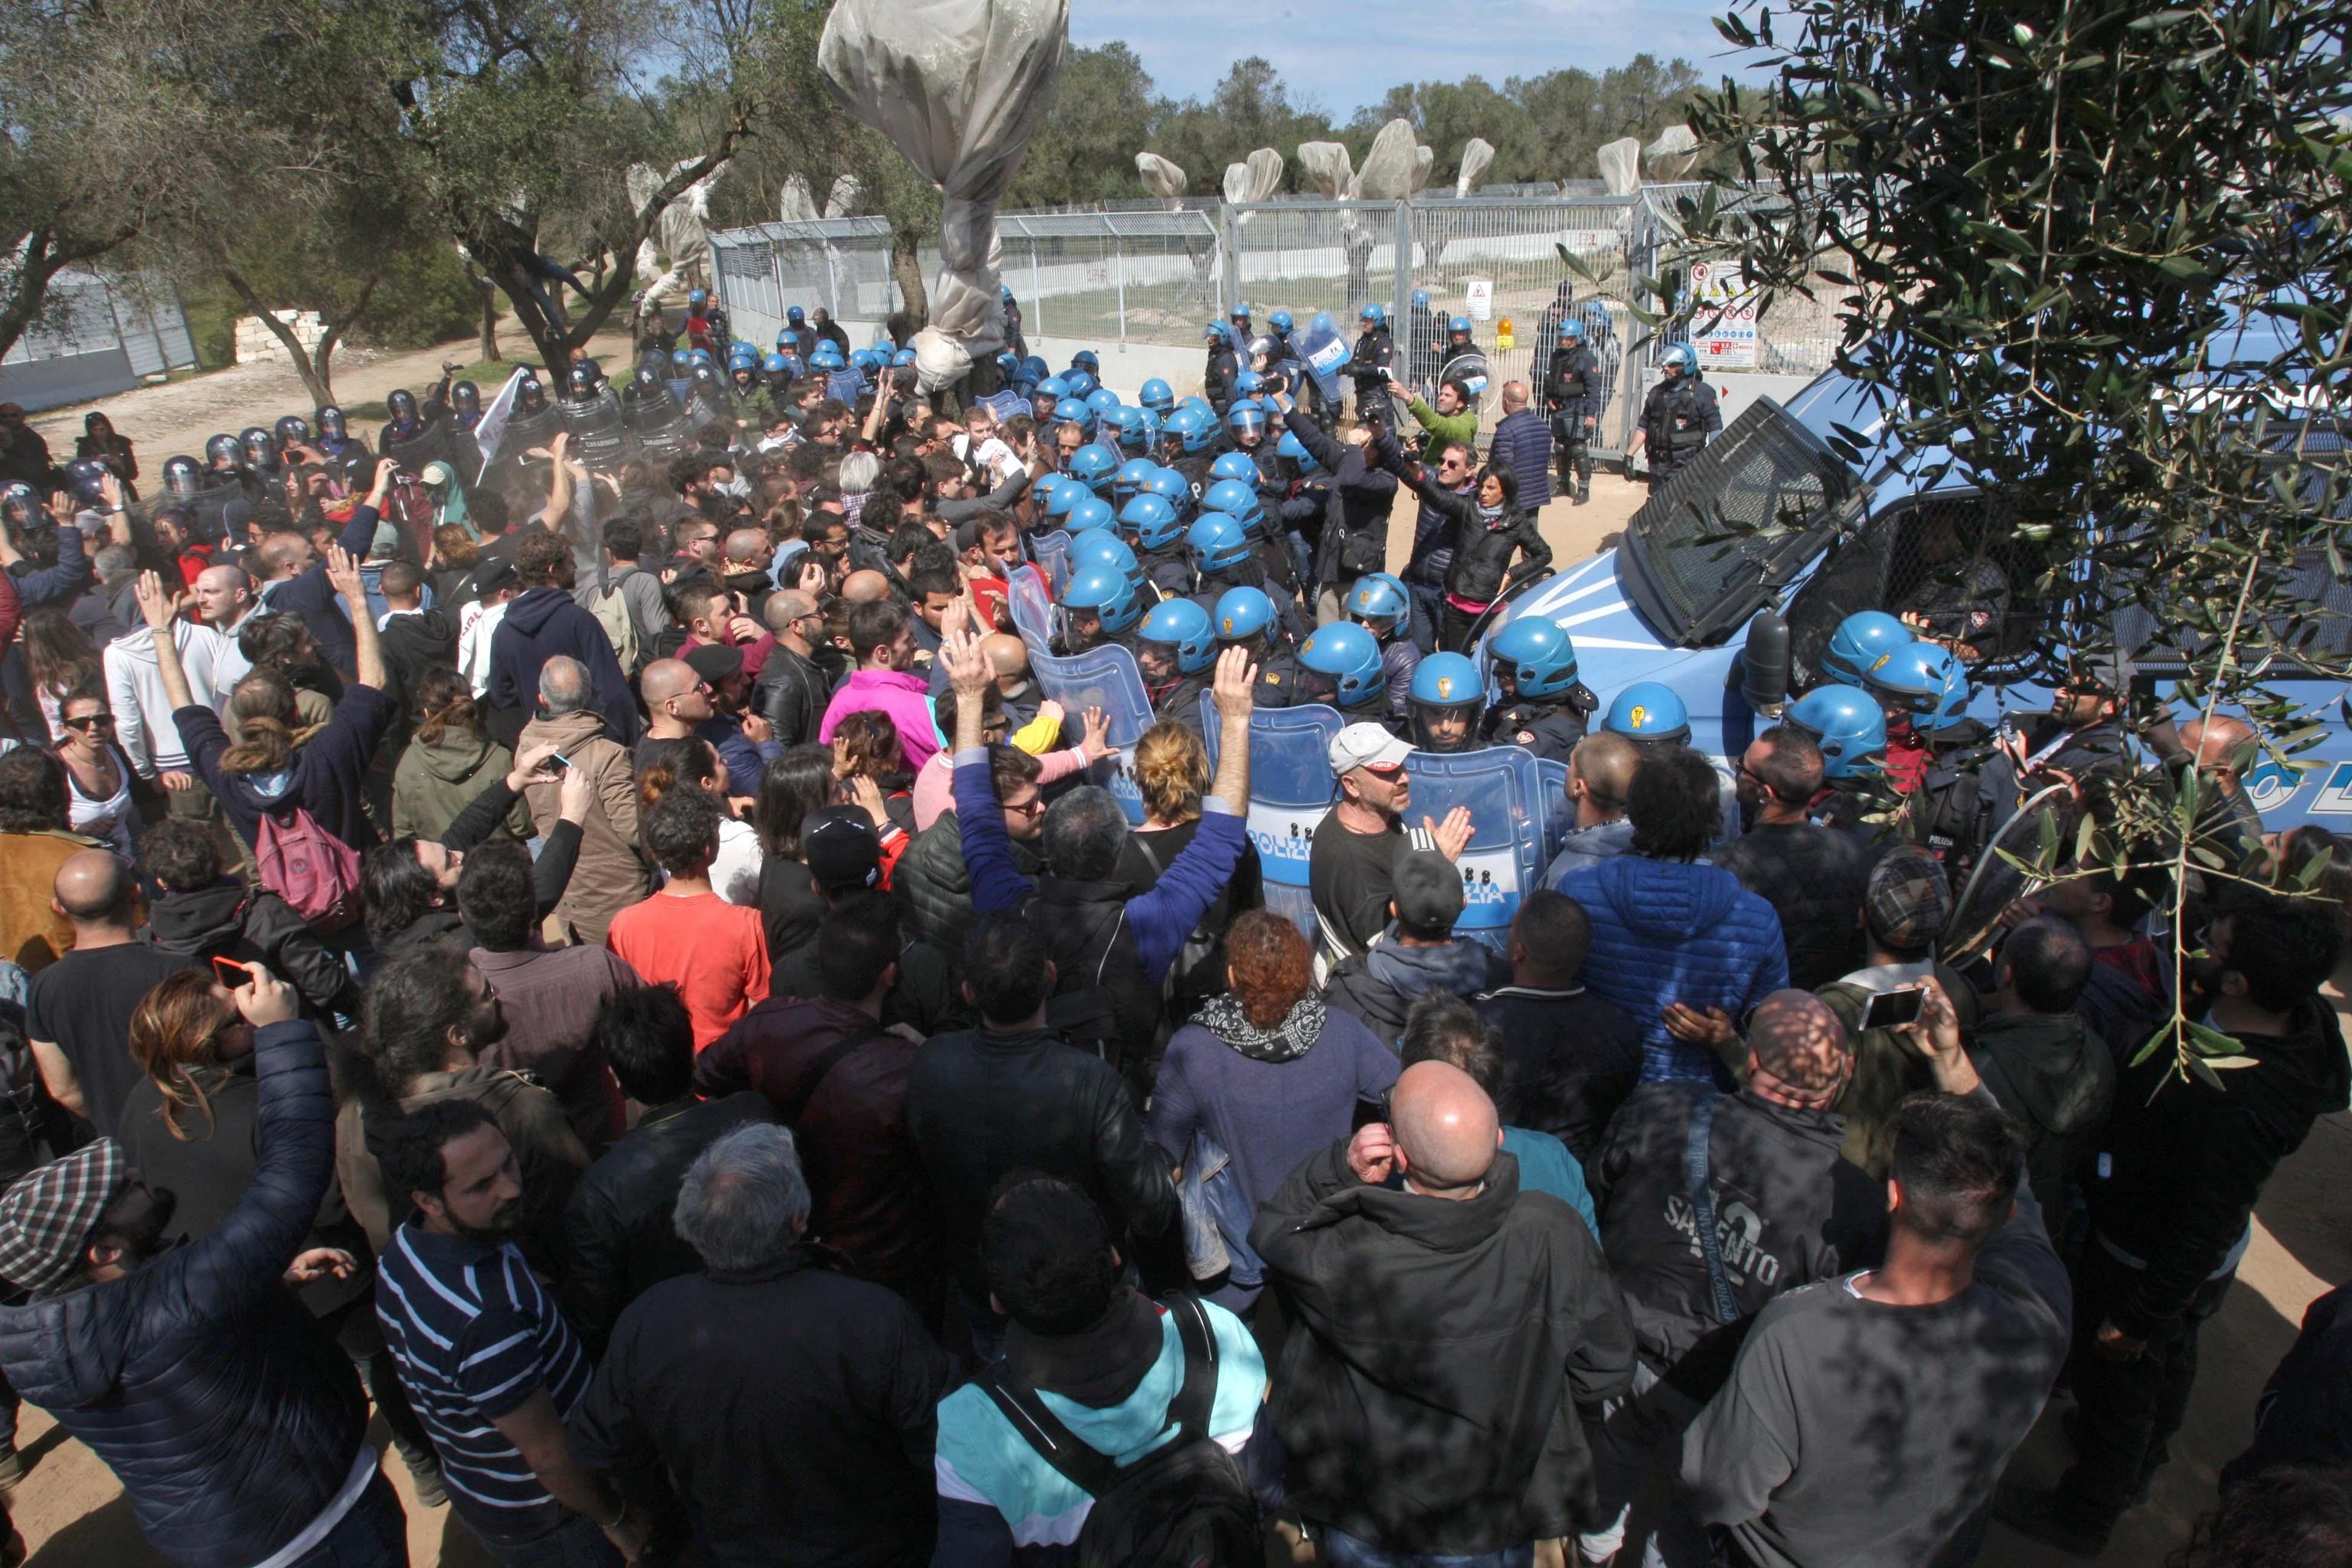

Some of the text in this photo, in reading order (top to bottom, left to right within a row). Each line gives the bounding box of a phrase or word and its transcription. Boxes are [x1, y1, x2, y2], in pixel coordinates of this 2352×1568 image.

[2241, 760, 2352, 814] OL
[1246, 829, 1312, 861] POLIZI
[1463, 881, 1506, 903] ZIA
[1663, 1194, 1779, 1286] SAENTO
[1713, 1276, 1738, 1323] MPORIO
